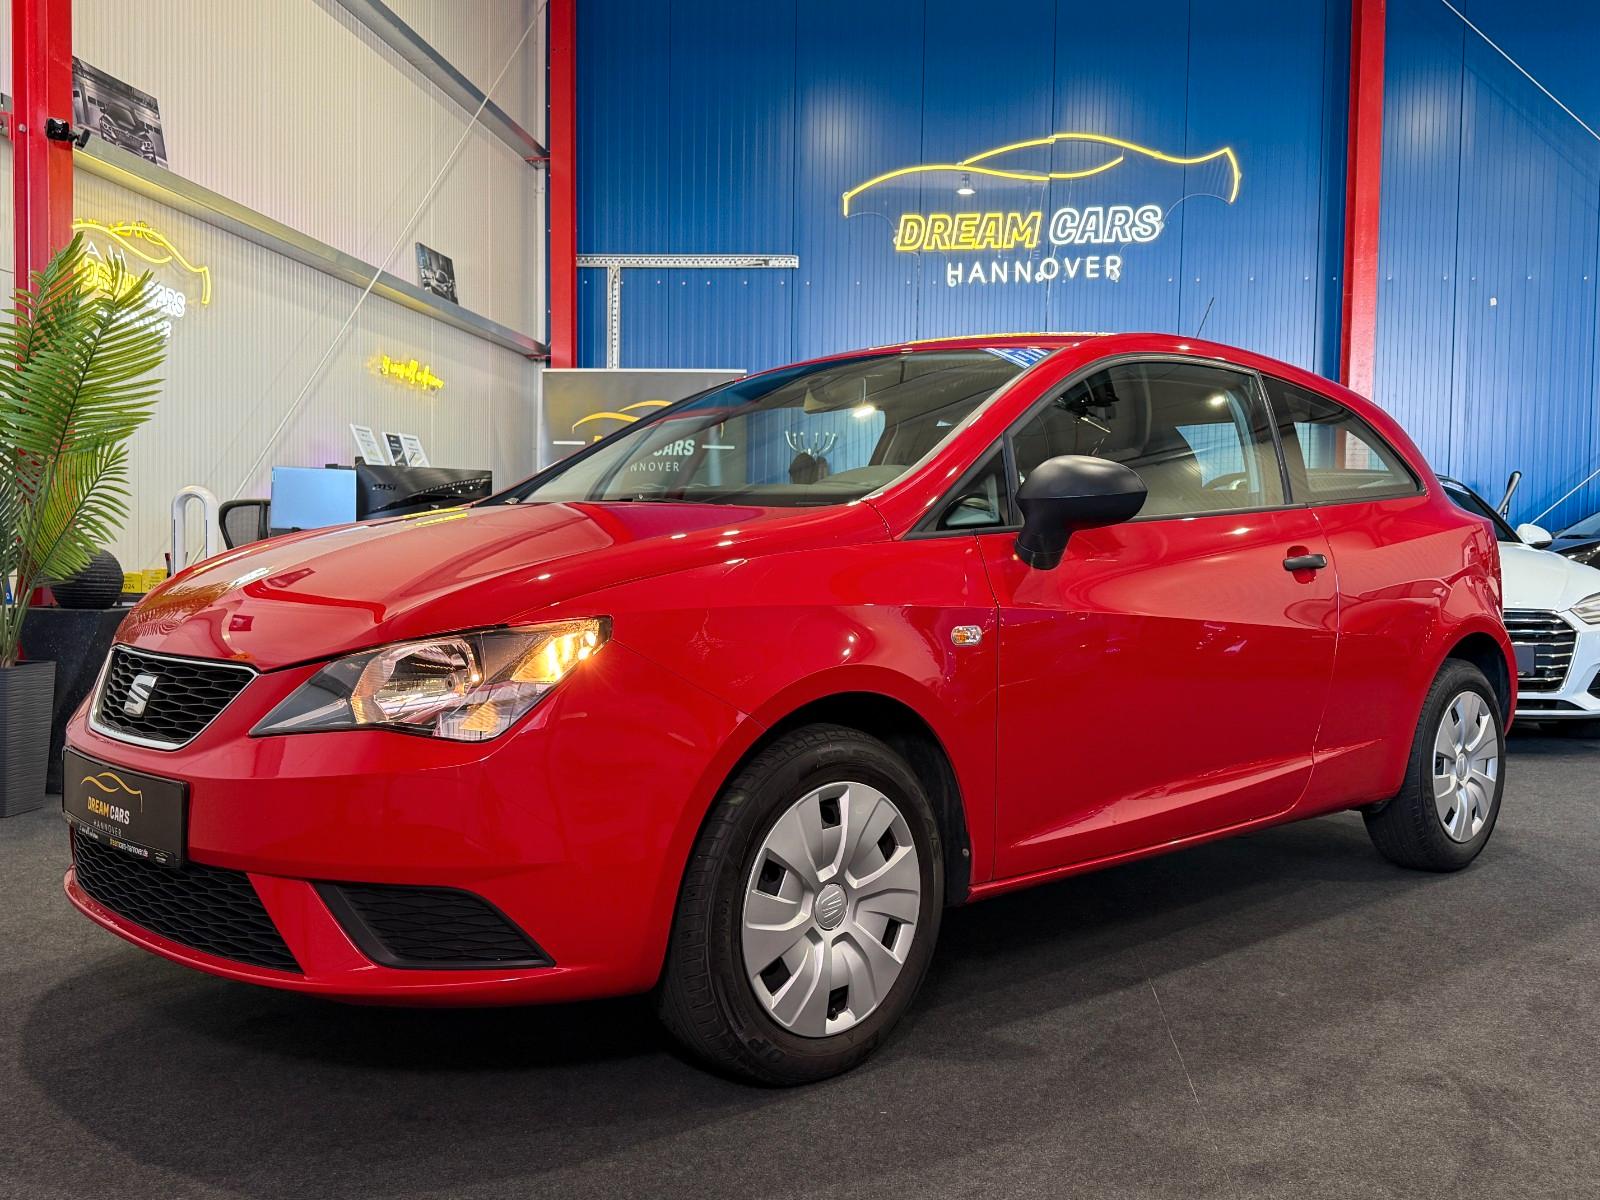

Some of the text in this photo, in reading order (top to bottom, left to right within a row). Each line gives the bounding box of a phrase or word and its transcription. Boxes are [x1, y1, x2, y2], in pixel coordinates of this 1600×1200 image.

[895, 204, 1162, 251] DREAM CARS
[946, 255, 1123, 286] HANNOVER
[87, 796, 130, 825] DREAM CARS
[93, 820, 122, 837] HANNOVER
